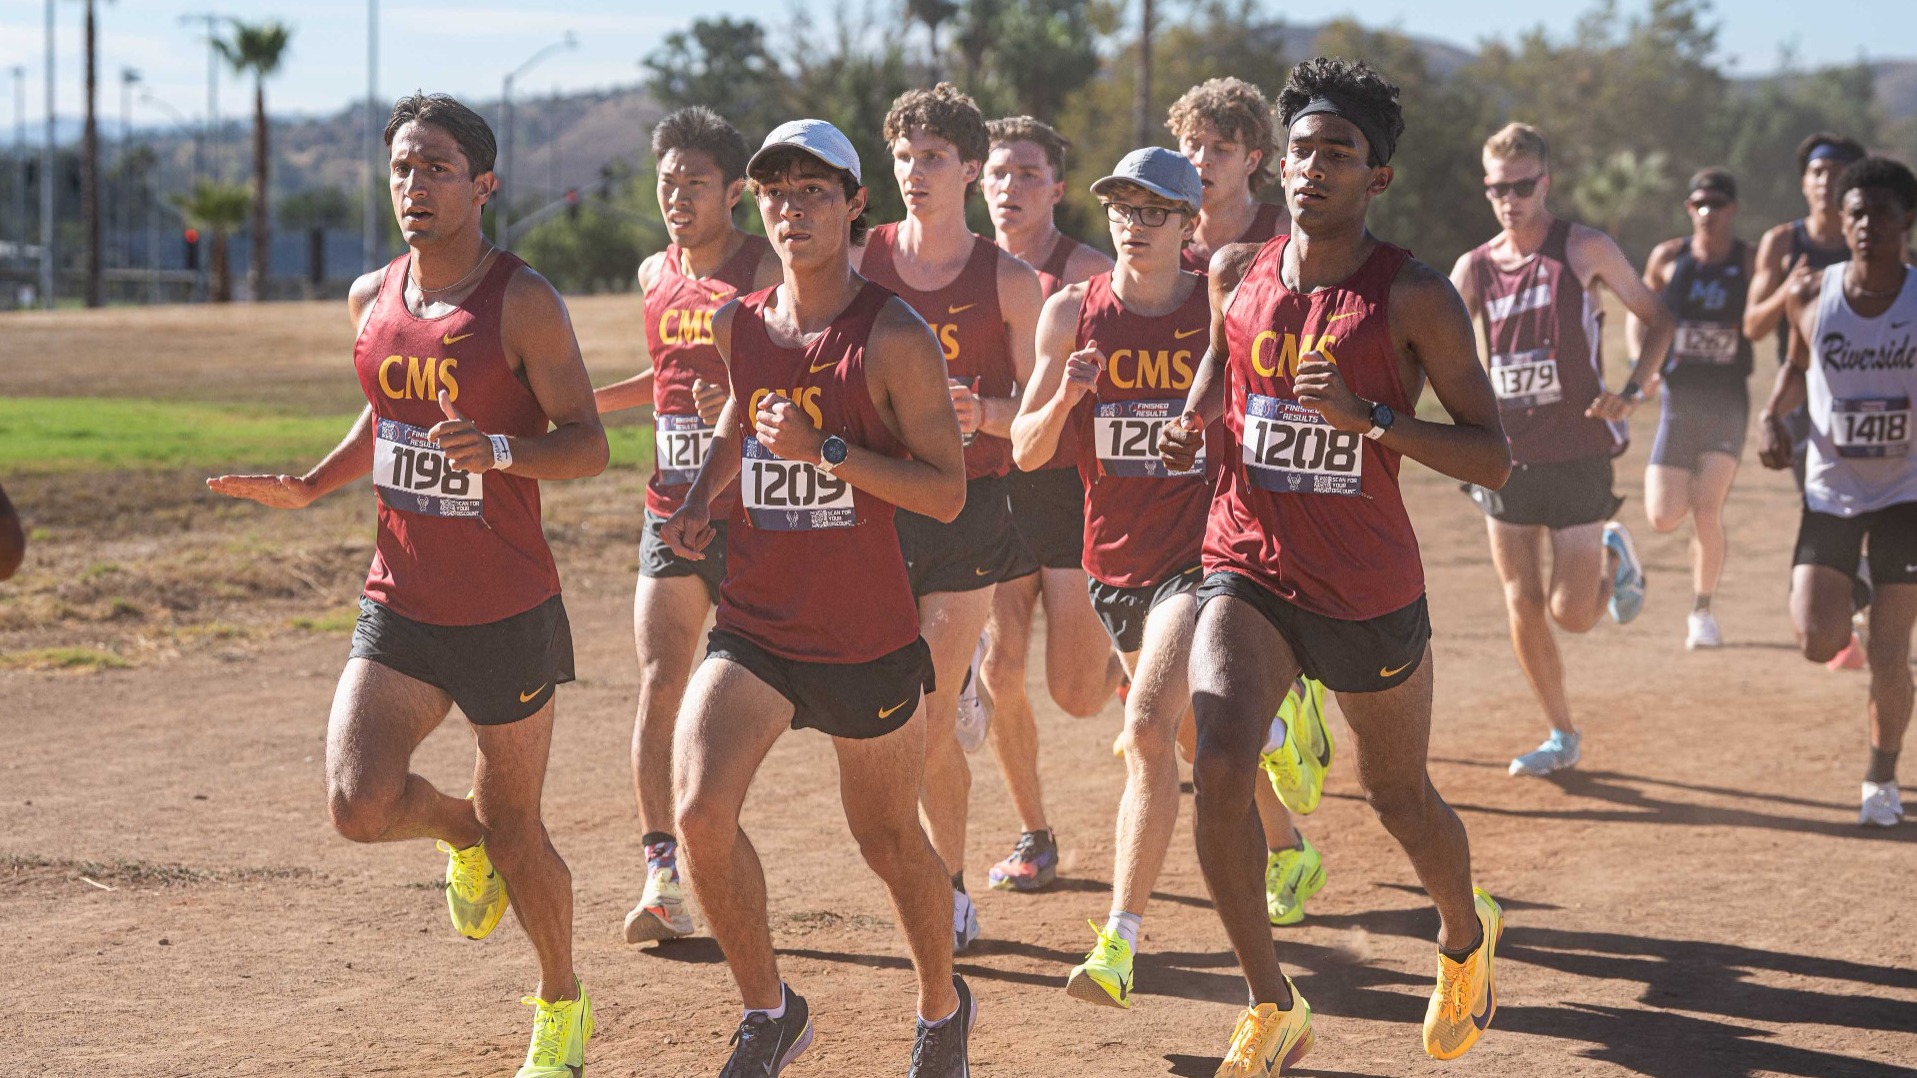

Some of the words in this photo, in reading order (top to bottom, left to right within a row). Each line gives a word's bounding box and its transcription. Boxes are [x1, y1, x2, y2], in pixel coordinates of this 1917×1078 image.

[659, 309, 714, 345] CMS
[1109, 349, 1194, 390] CMS
[1250, 330, 1337, 378] CMS
[1822, 332, 1917, 373] Riverside
[378, 355, 459, 402] CMS
[1501, 364, 1553, 393] 1379
[1109, 421, 1171, 456] 120
[1282, 413, 1319, 423] RESULTS
[1845, 413, 1907, 442] 1418
[1254, 421, 1360, 472] 1208
[392, 446, 470, 496] 1198
[752, 462, 847, 506] 1209
